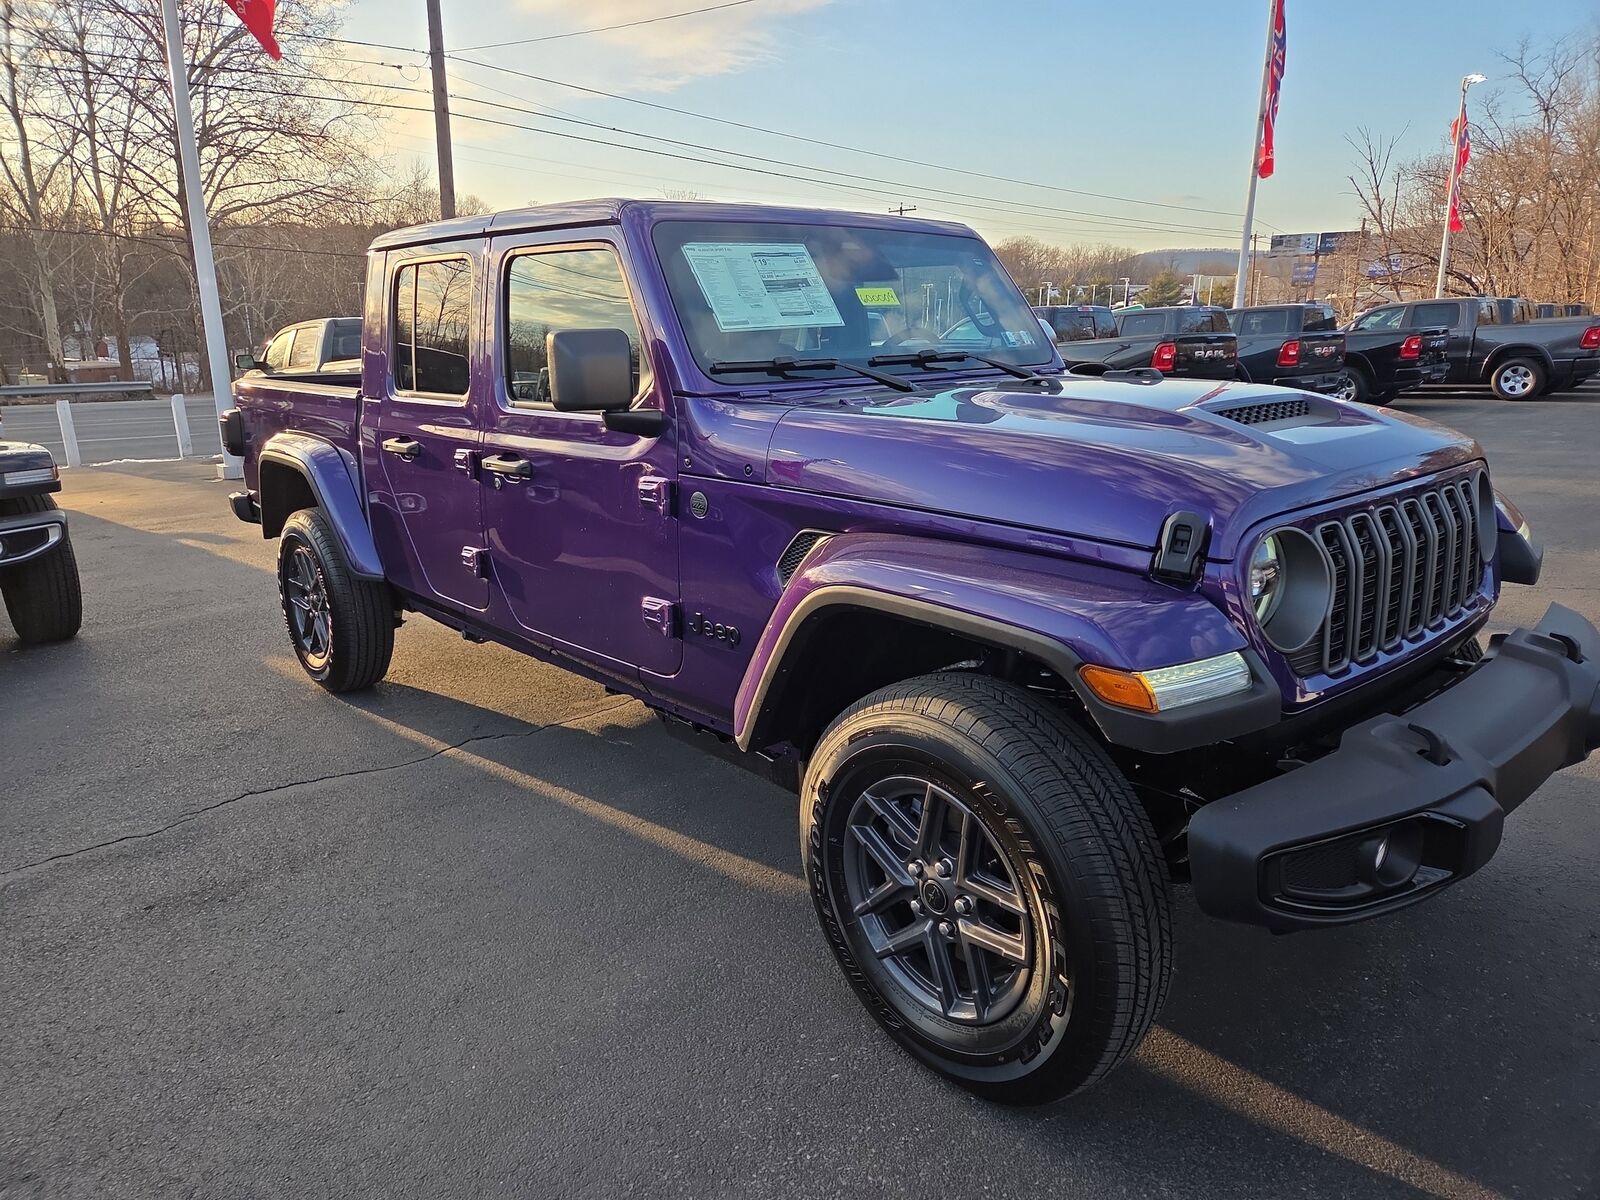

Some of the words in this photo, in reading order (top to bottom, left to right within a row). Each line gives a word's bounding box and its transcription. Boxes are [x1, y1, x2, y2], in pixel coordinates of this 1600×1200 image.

[1194, 349, 1224, 359] RAM
[1314, 346, 1337, 355] RAM
[688, 611, 741, 648] Jeep
